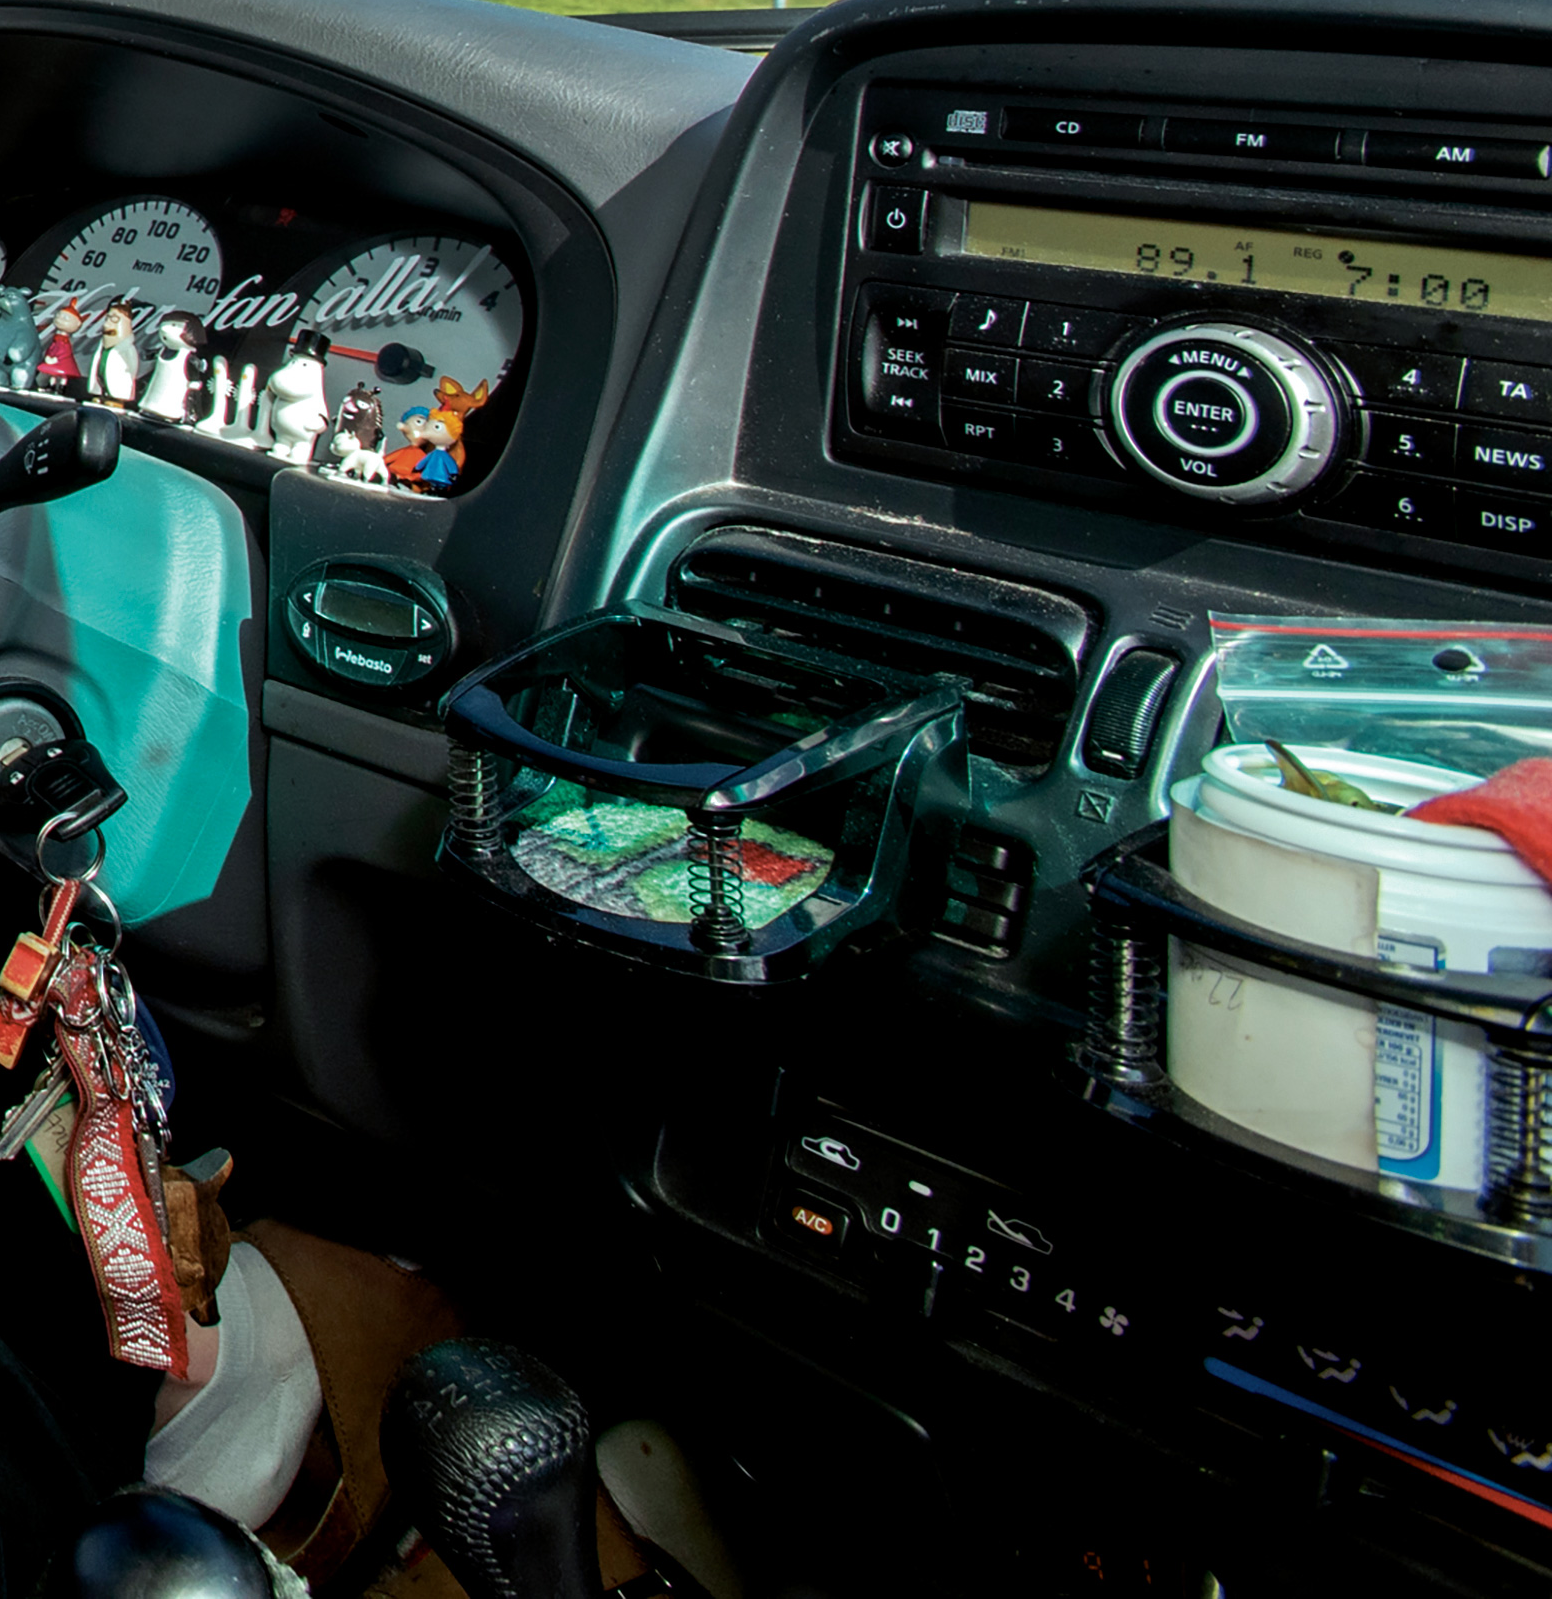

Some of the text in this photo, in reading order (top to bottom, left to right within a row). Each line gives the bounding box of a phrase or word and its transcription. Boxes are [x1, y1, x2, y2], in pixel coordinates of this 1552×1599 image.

[1055, 121, 1081, 134] CD
[1235, 130, 1267, 149] FM
[1435, 145, 1474, 163] AM
[111, 226, 138, 246] 80
[147, 219, 181, 240] 100
[176, 243, 211, 264] 120
[1233, 240, 1256, 253] AF
[1292, 246, 1324, 262] REG
[81, 249, 108, 268] 60
[132, 258, 165, 275] km/h
[420, 257, 440, 278] 3
[1135, 243, 1257, 286] 89.1
[184, 274, 220, 296] 140
[192, 274, 300, 334] fan
[314, 244, 493, 324] alla!
[1345, 263, 1492, 312] 7:00
[479, 290, 501, 312] 4
[1060, 321, 1071, 337] 1
[887, 346, 925, 366] SEEK
[1181, 348, 1239, 373] MENU
[881, 360, 930, 382] TRACK
[964, 367, 998, 386] MIX
[1401, 366, 1419, 387] 4
[1052, 379, 1065, 395] 2
[1499, 378, 1532, 400] TA
[1173, 399, 1234, 424] ENTER
[964, 422, 996, 440] RPT
[1052, 437, 1064, 453] 3
[1398, 433, 1414, 452] 5
[1179, 457, 1218, 479] VOL
[1473, 445, 1543, 472] NEWS
[1397, 496, 1414, 515] 6
[1480, 508, 1535, 535] DISP
[335, 645, 393, 675] Webasto
[417, 653, 433, 665] set
[794, 1207, 829, 1234] A/C
[880, 1206, 1076, 1313] 0 1 2 3 4
